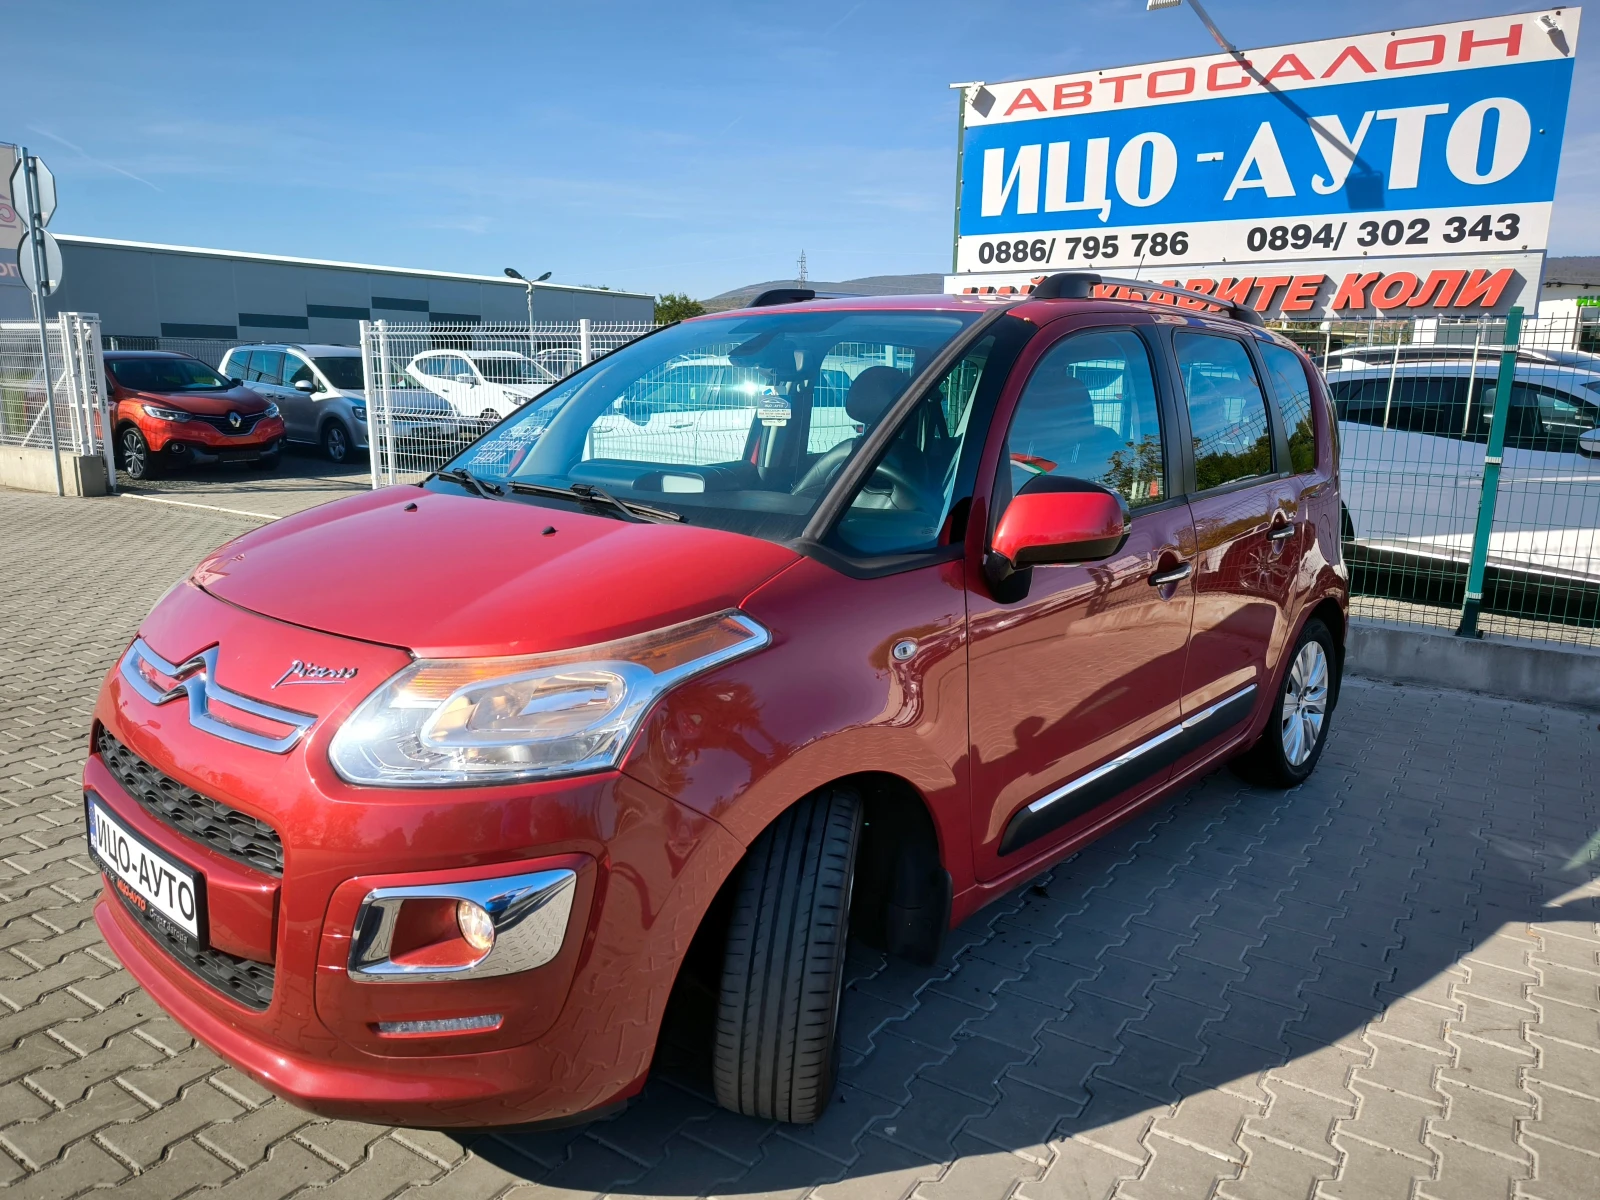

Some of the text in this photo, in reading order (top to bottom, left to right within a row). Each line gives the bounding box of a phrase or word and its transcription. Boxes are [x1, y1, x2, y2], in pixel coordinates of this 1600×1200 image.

[1003, 24, 1523, 116] АВТОСАЛОН
[981, 131, 1178, 223] ИЦО
[979, 231, 1189, 264] 0886/ 795 786
[1247, 213, 1520, 251] 0894/ 302 343
[1331, 268, 1515, 310] КОЛИ
[97, 814, 195, 921] ИЦО-АУТО
